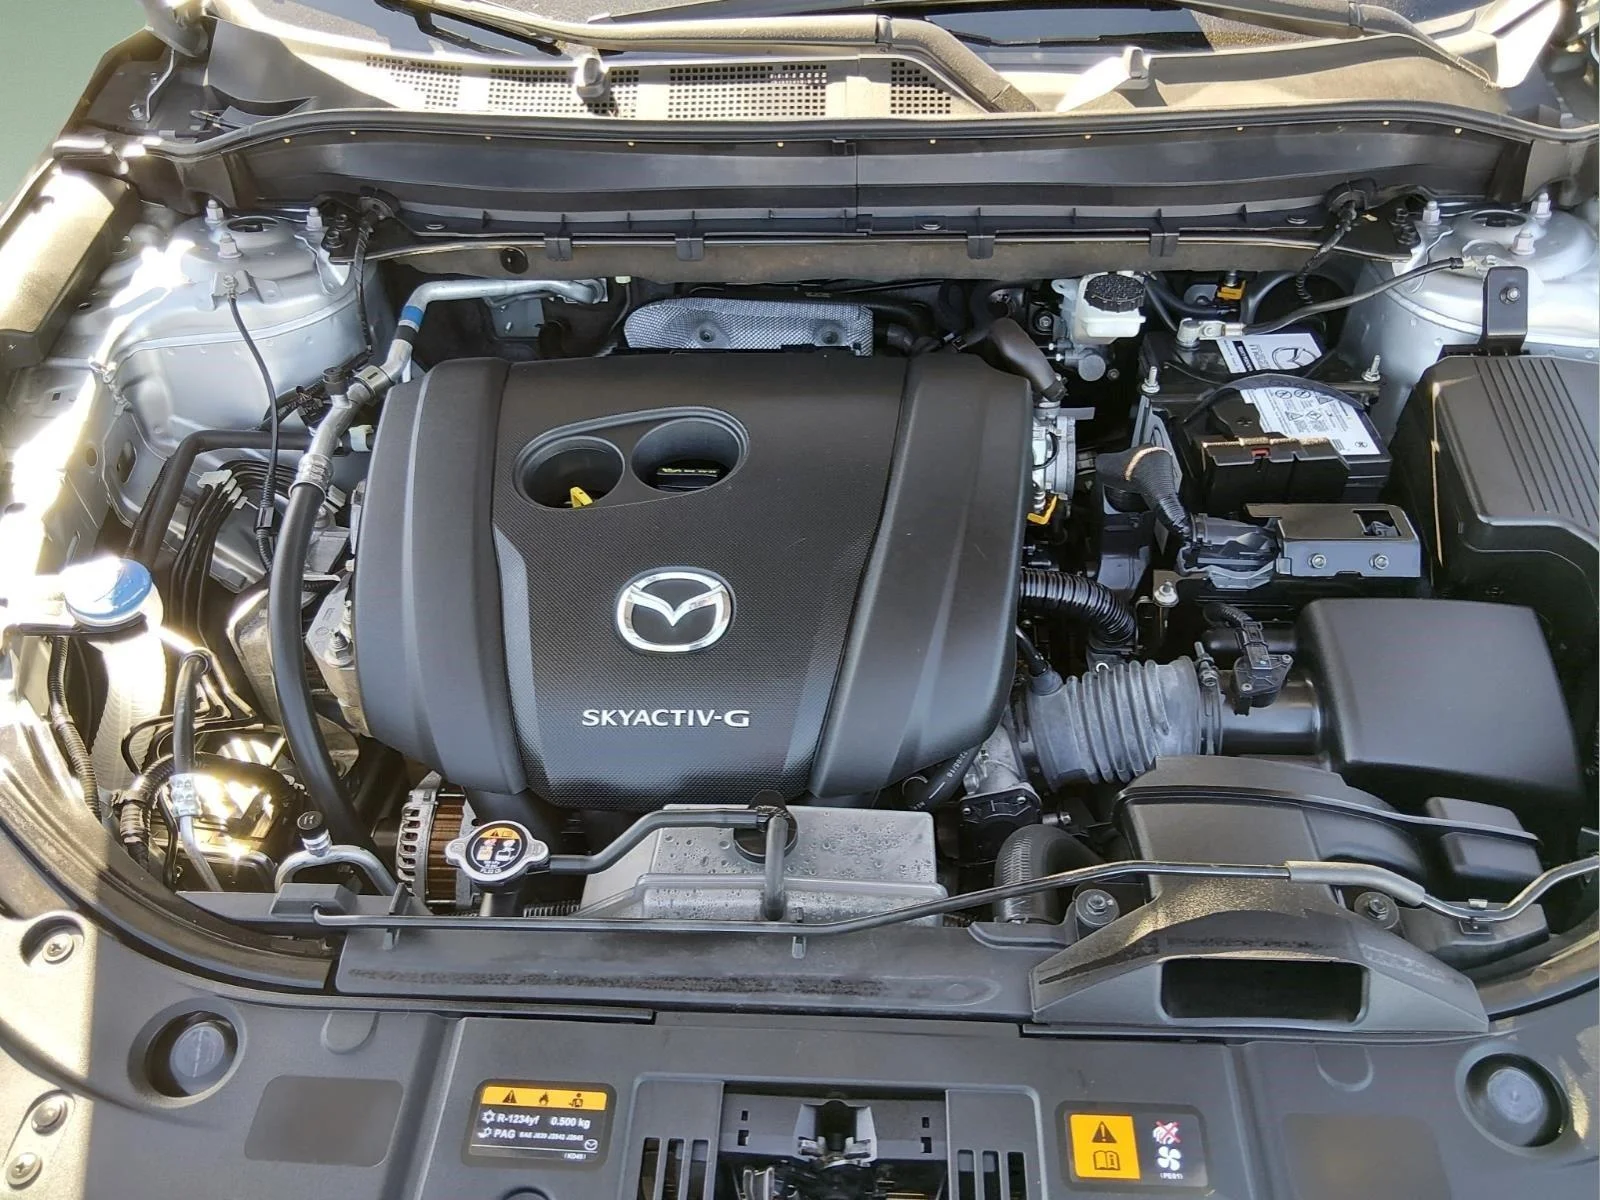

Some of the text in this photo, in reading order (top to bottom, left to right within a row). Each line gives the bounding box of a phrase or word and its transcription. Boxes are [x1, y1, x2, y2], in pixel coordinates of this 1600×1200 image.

[581, 709, 750, 727] SKYACTIV-G
[496, 1113, 591, 1129] R-1234yf 0.500 kg
[493, 1129, 516, 1139] PAG
